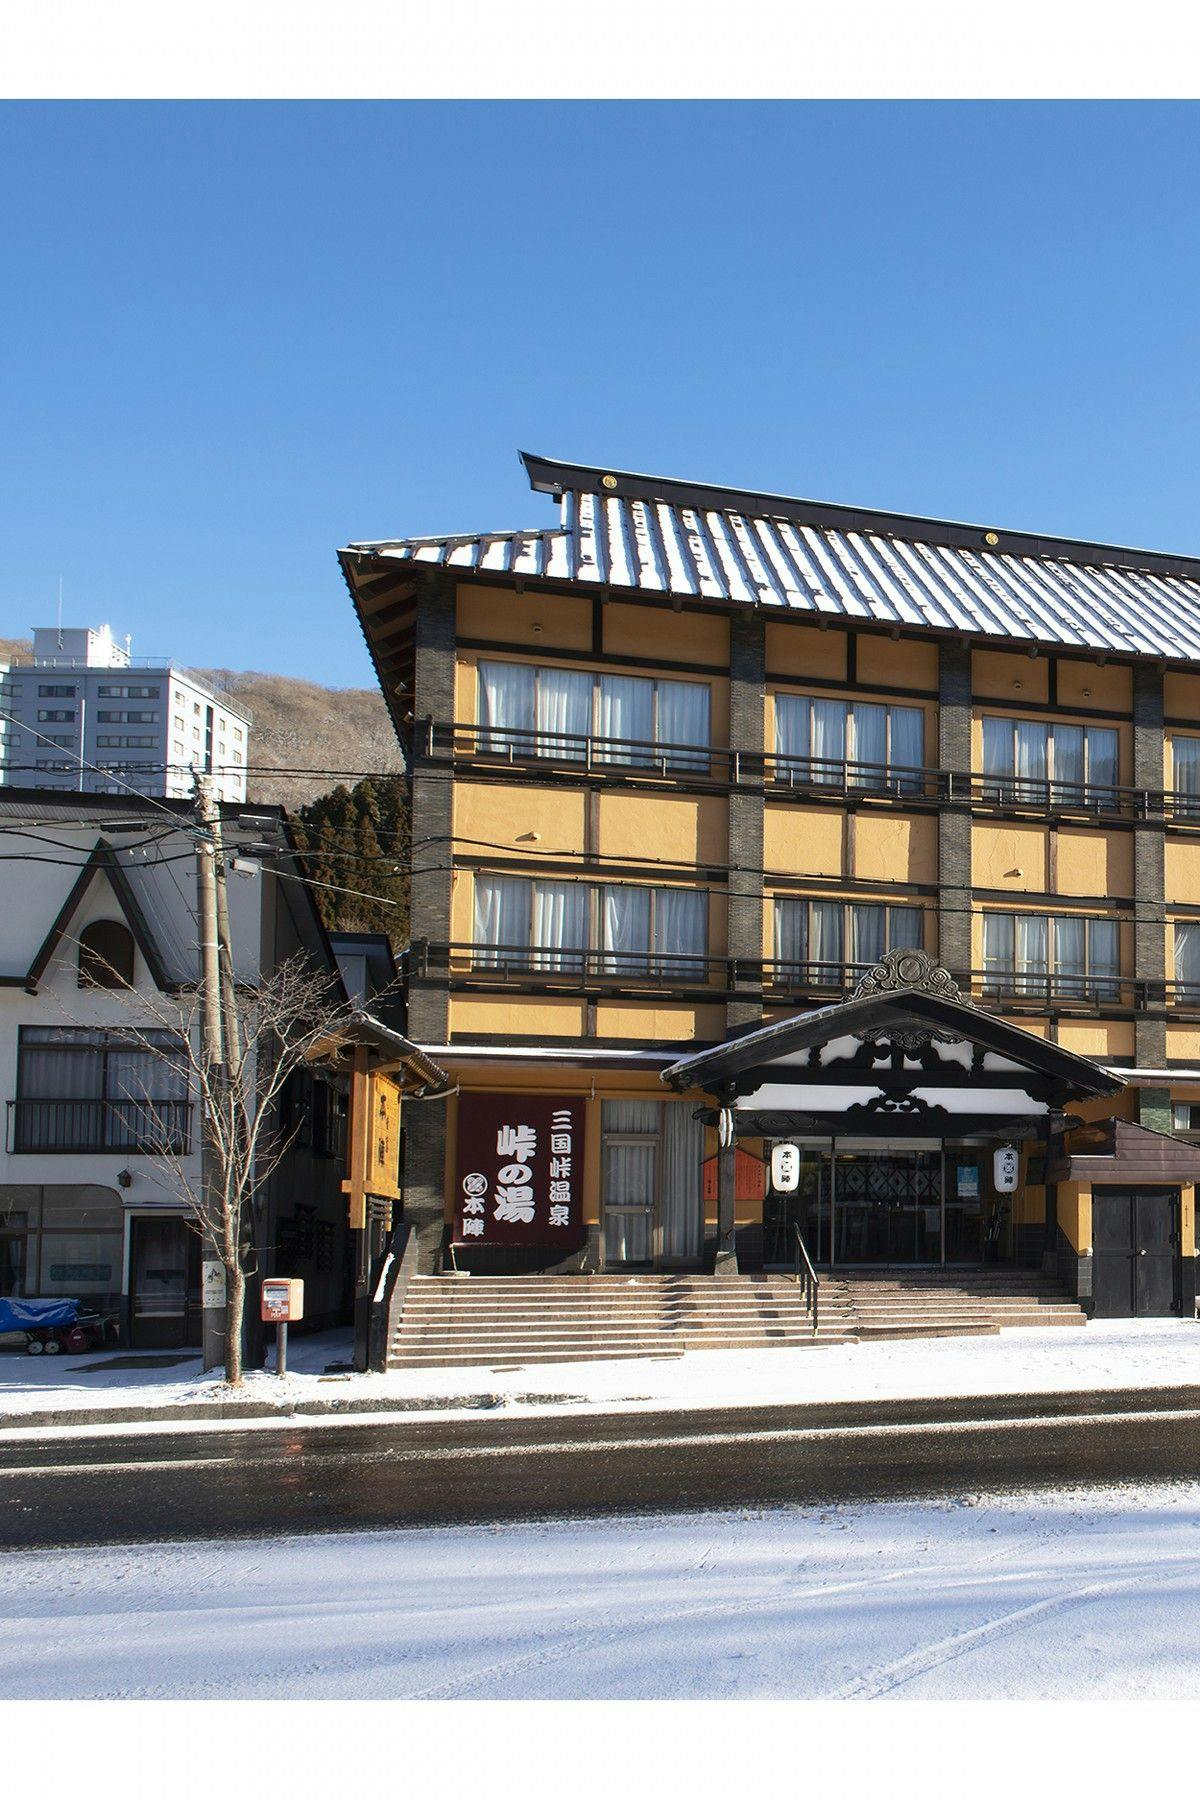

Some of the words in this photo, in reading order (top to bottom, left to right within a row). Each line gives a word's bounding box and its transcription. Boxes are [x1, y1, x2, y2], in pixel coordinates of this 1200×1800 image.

[463, 1197, 485, 1236] 本陣
[493, 1125, 537, 1223] 峠の湯
[549, 1109, 572, 1227] 三国峠温泉
